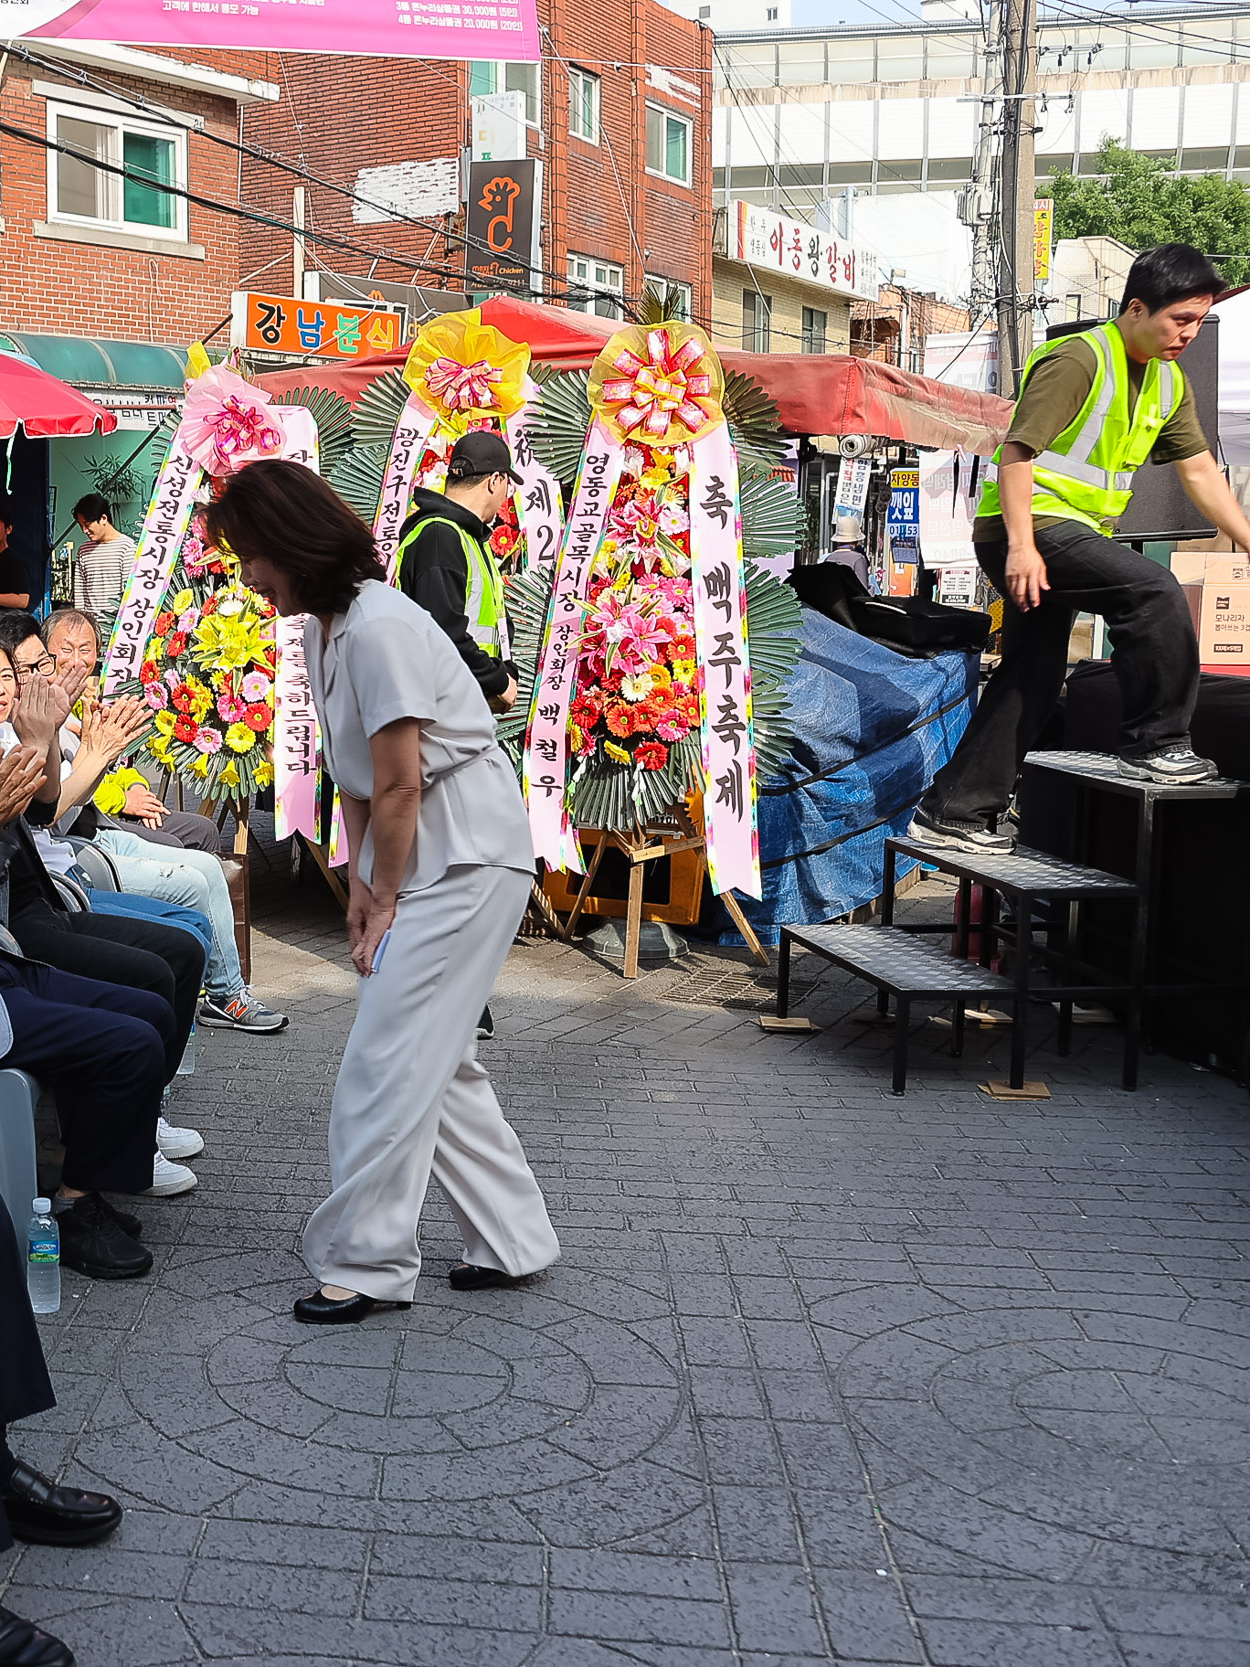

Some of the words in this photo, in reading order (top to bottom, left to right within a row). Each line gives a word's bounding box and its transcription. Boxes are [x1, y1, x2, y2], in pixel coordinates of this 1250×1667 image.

[255, 301, 395, 354] 강남분식
[135, 454, 194, 591] 신성전통시장
[699, 475, 734, 530] 축
[555, 453, 610, 613] 영동교골목시장
[1214, 613, 1246, 624] 모나리자
